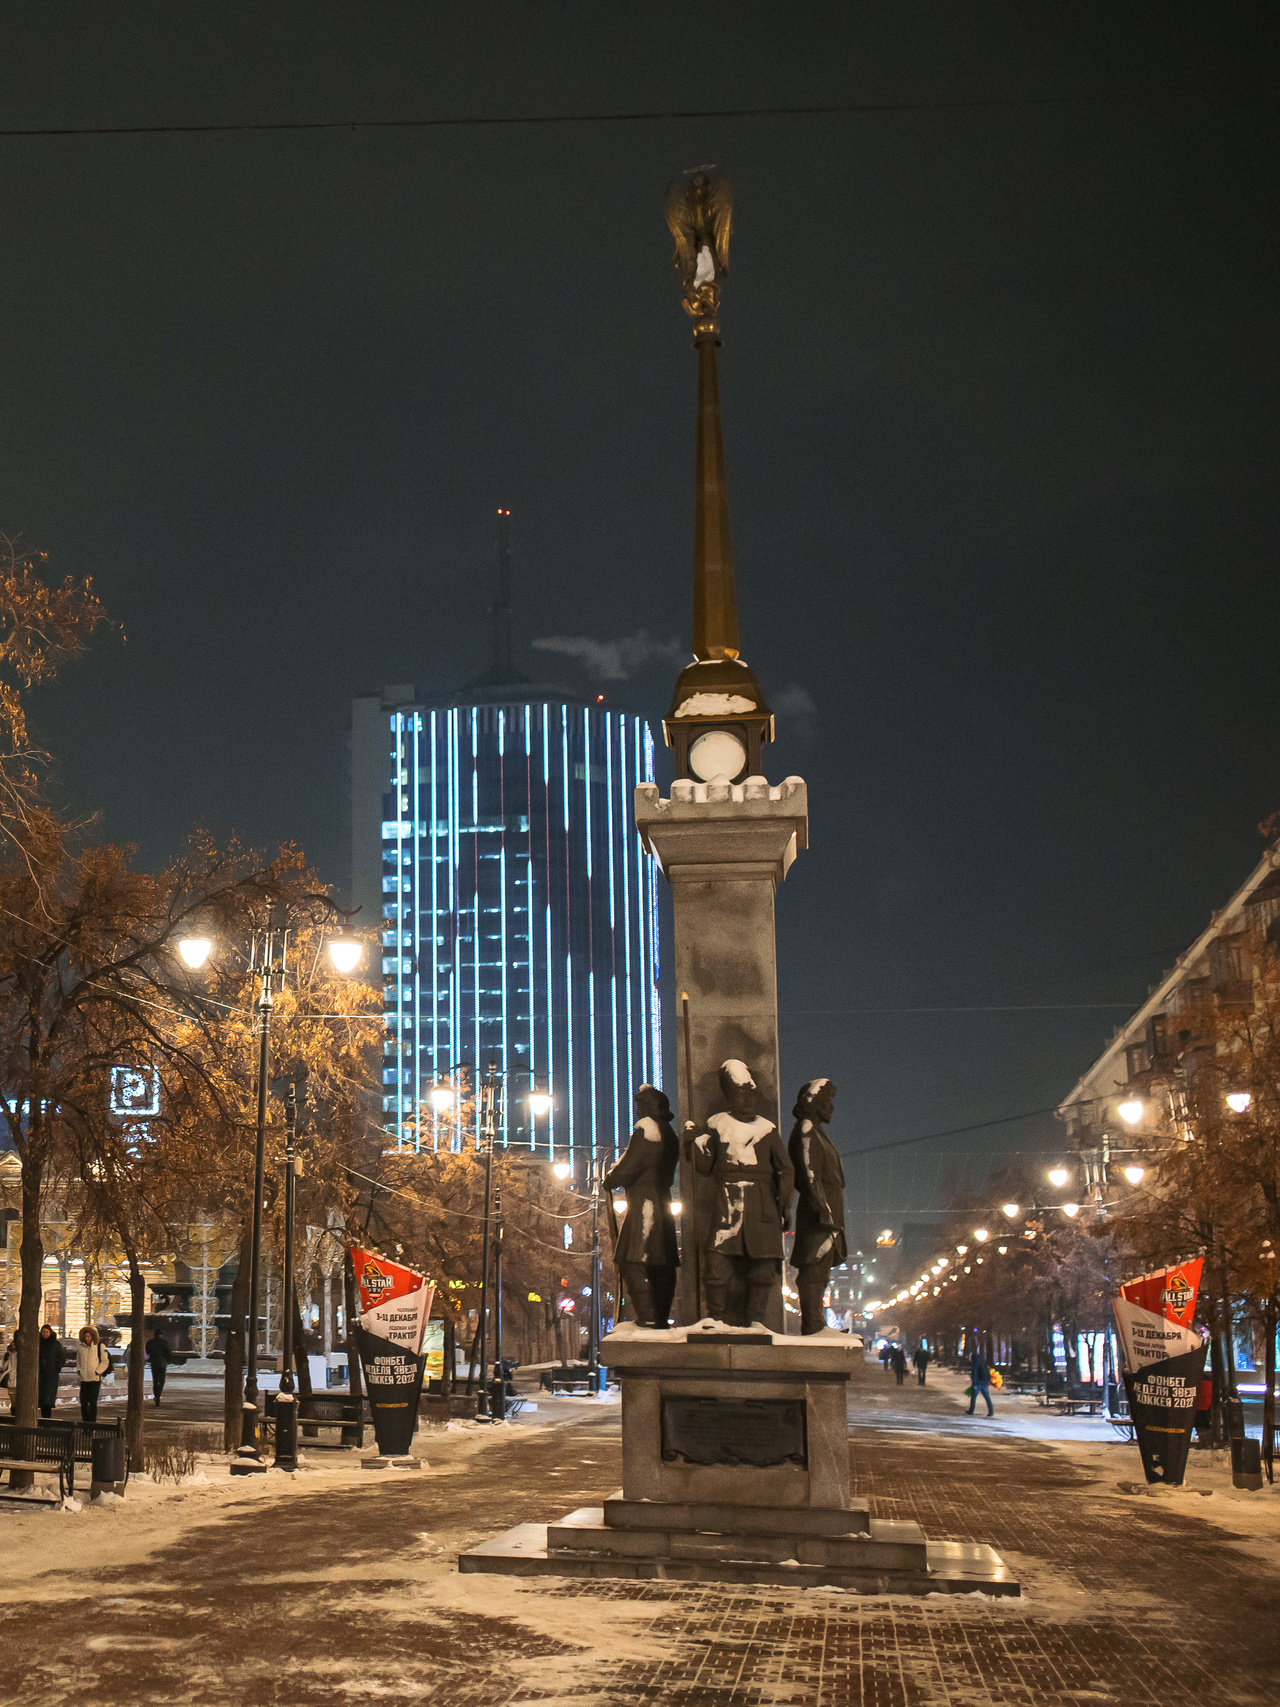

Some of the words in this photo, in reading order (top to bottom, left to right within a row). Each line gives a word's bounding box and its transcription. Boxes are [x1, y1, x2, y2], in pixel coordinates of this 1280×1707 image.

[1145, 1330, 1182, 1340] ДЕКАБРЯ
[374, 1355, 406, 1366] ФОНБЕТ
[395, 1373, 415, 1385] 2022
[1147, 1374, 1186, 1387] ФОНБЕТ
[1133, 1381, 1169, 1397] НЕДЕЛЯ
[1136, 1392, 1172, 1408] ХОККЕЯ
[1173, 1396, 1195, 1409] 2022
